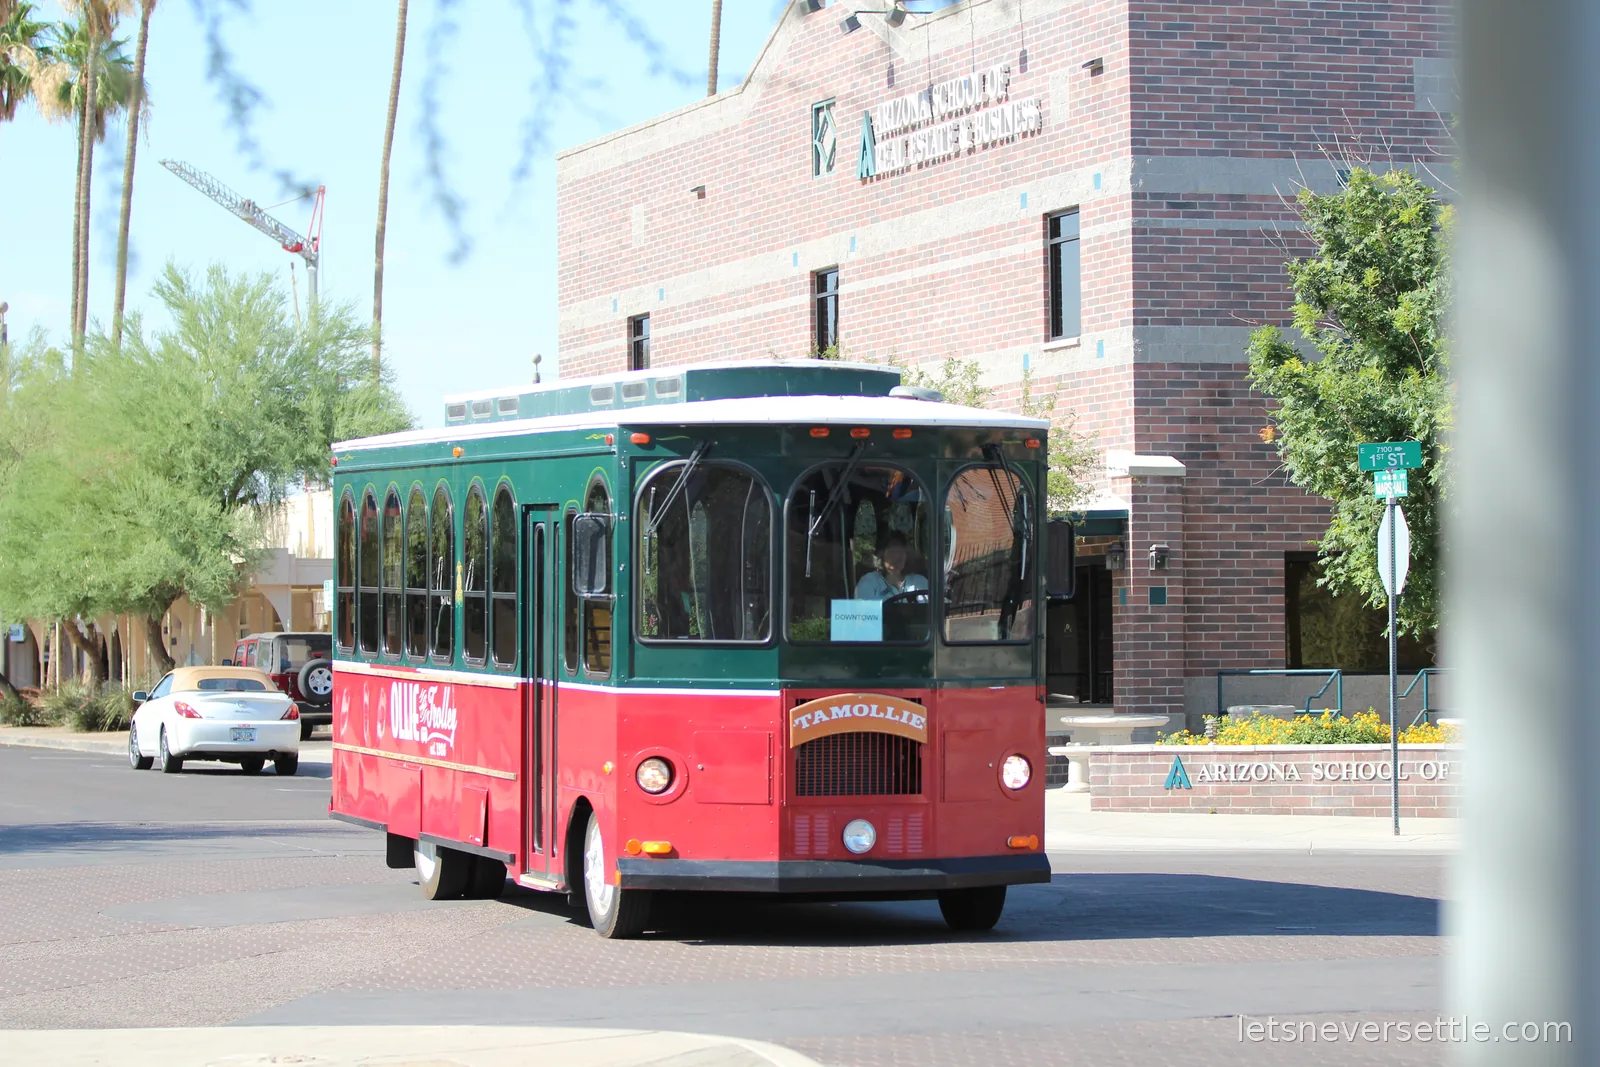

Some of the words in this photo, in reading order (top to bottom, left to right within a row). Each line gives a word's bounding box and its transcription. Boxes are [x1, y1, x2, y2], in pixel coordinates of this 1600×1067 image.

[875, 91, 933, 133] ARIZONA
[932, 72, 985, 115] SCHOOL
[987, 64, 1010, 99] OF
[875, 138, 907, 174] REAL
[909, 123, 958, 162] ESTATE
[975, 97, 1041, 144] BUSINESS
[1387, 452, 1410, 466] ST.
[834, 613, 879, 621] DOWNTOWN
[390, 681, 420, 742] OLLIE
[427, 685, 458, 748] Trolley
[794, 704, 926, 730] TAMOLLIE
[1197, 763, 1302, 783] ARIZONA
[1312, 762, 1409, 782] SCHOOL
[1419, 761, 1450, 781] OF
